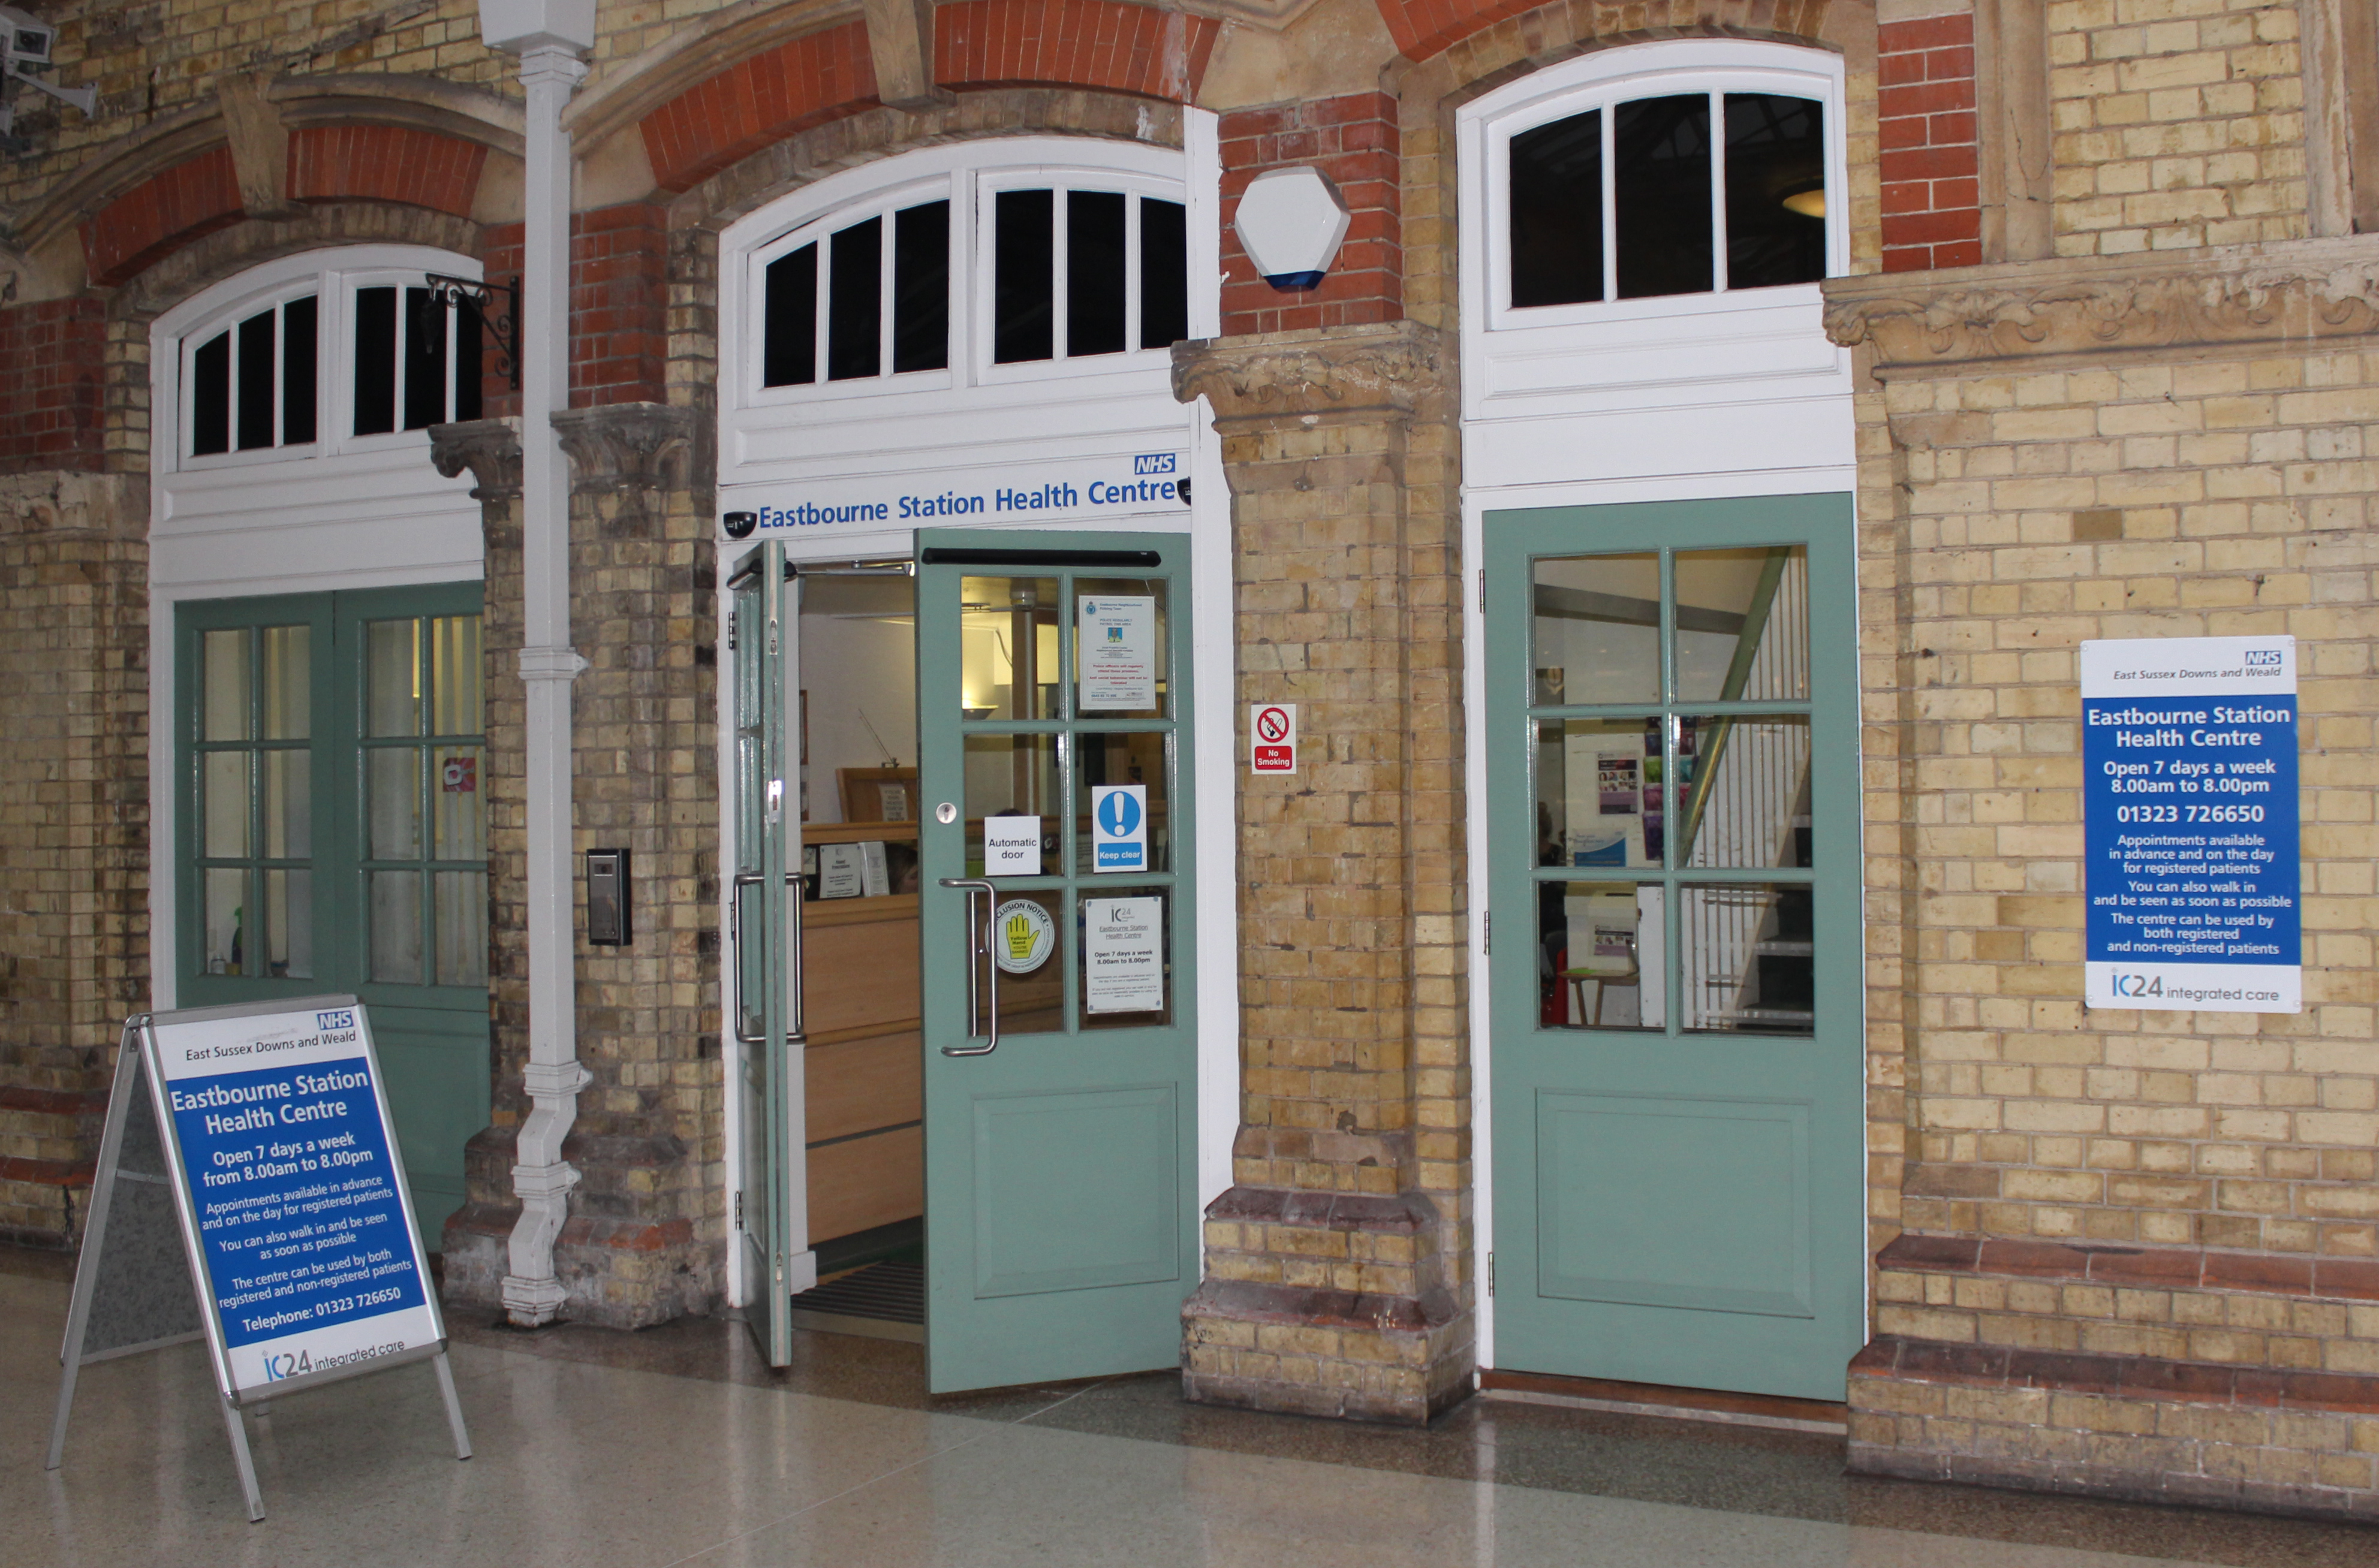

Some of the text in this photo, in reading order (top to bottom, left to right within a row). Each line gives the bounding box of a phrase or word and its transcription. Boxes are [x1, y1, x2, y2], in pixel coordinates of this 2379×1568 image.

[1136, 454, 1174, 474] NHS
[759, 479, 1175, 529] Eastbourne Station Health Centre
[2247, 651, 2281, 665] NHS
[2113, 667, 2282, 680] East Sussex Downs and Weald
[2088, 705, 2291, 725] Eastbourne Station
[2116, 728, 2262, 747] Health Centre
[1257, 758, 1290, 767] Smoking
[2103, 758, 2276, 779] Open 7 days a week
[2111, 777, 2270, 795] 8.00am to 8.00pm
[2117, 804, 2265, 822] 01323 726650
[988, 838, 1037, 848] Automatic
[2116, 833, 2266, 848] Appointments available
[1001, 851, 1025, 859] door
[1100, 852, 1119, 860] Keep
[2109, 847, 2275, 863] in advance and on the day
[2122, 861, 2261, 876] for registered patients
[2128, 880, 2256, 892] You can also walk in
[2093, 893, 2292, 909] and be seen as soon as possible
[996, 903, 1049, 925] CLUSION NOTICE
[2110, 912, 2275, 928] The centre can be used by
[2143, 926, 2240, 942] both registered
[2107, 940, 2279, 956] and non-registered patients
[2166, 987, 2242, 1002] integrated
[2245, 991, 2280, 1001] care
[320, 1011, 353, 1029] NHS
[185, 1030, 356, 1061] East Sussex Downs and Weald
[170, 1069, 368, 1112] Eastbourne Station
[204, 1100, 347, 1135] Health Centre
[212, 1130, 356, 1168] Open 7 days a week
[202, 1150, 374, 1187] from 8.00am to 8.00pm
[206, 1176, 383, 1216] Appointments available in advance
[201, 1188, 393, 1230] and on the day for registered patients
[218, 1213, 387, 1252] You can also walk in and be seen
[259, 1231, 356, 1260] as soon as possible
[231, 1248, 392, 1290] The centre can be used by both
[218, 1260, 412, 1309] registered and non-registered patients
[241, 1286, 401, 1332] Telephone: 01323 726650
[378, 1340, 405, 1355] care
